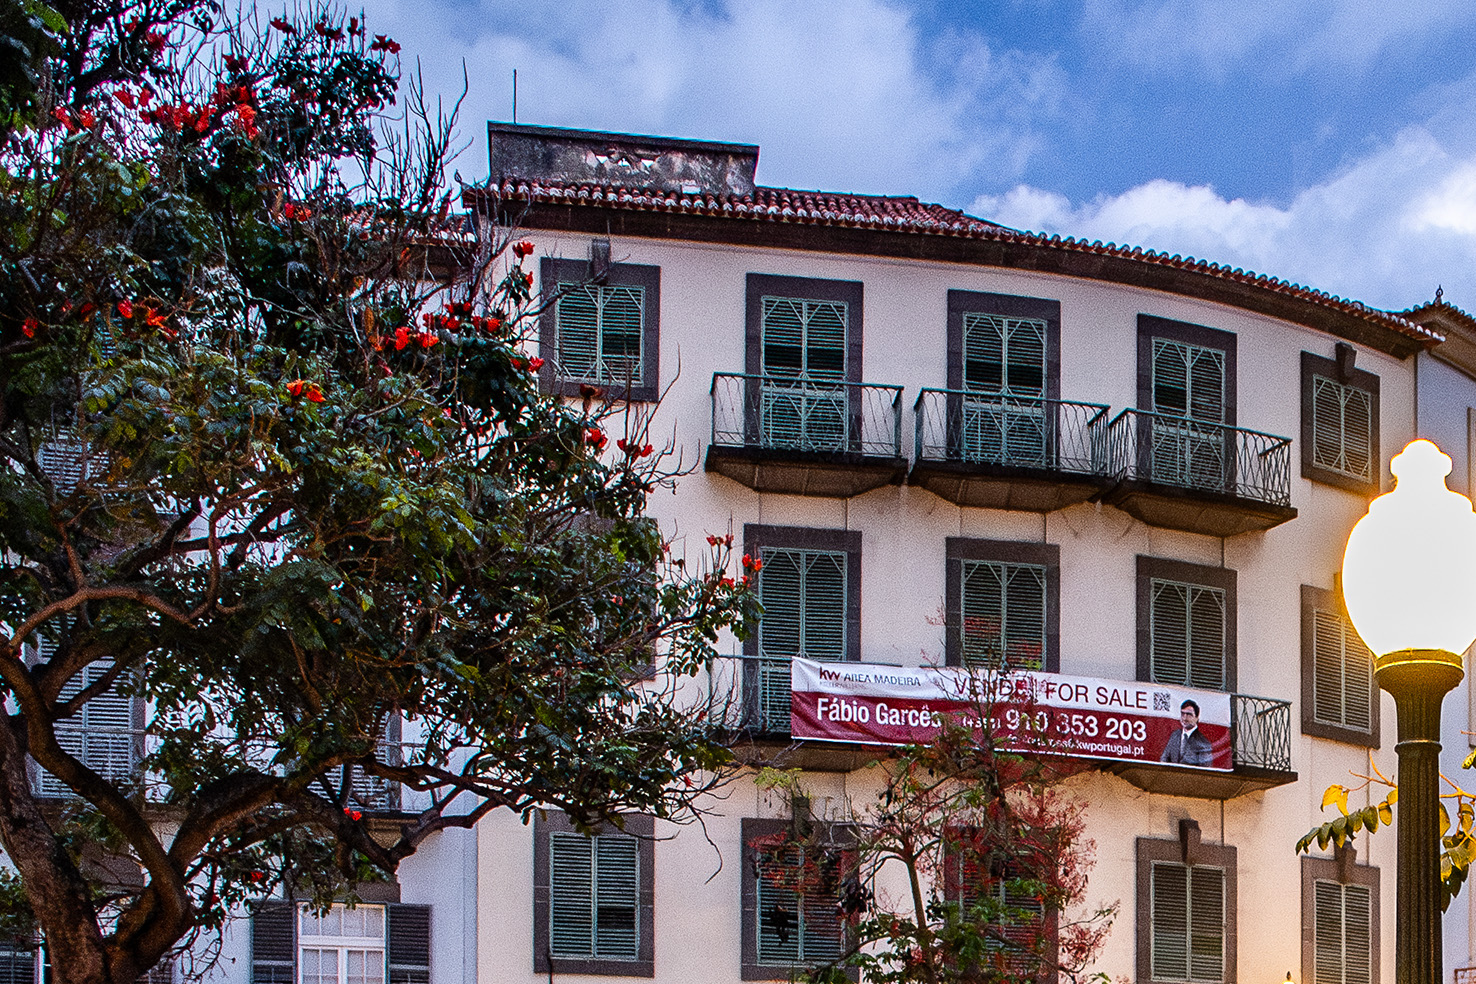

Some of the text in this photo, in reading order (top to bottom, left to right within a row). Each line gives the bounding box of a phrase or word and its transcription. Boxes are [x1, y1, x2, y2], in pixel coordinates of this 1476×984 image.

[844, 672, 871, 683] AREA
[874, 674, 921, 686] MADEIRA
[1045, 682, 1089, 703] FOR
[1095, 686, 1148, 709] SALE
[817, 697, 870, 724] Fábio
[875, 703, 942, 728] Garcês
[1056, 713, 1099, 737] 353
[1105, 717, 1147, 742] 203
